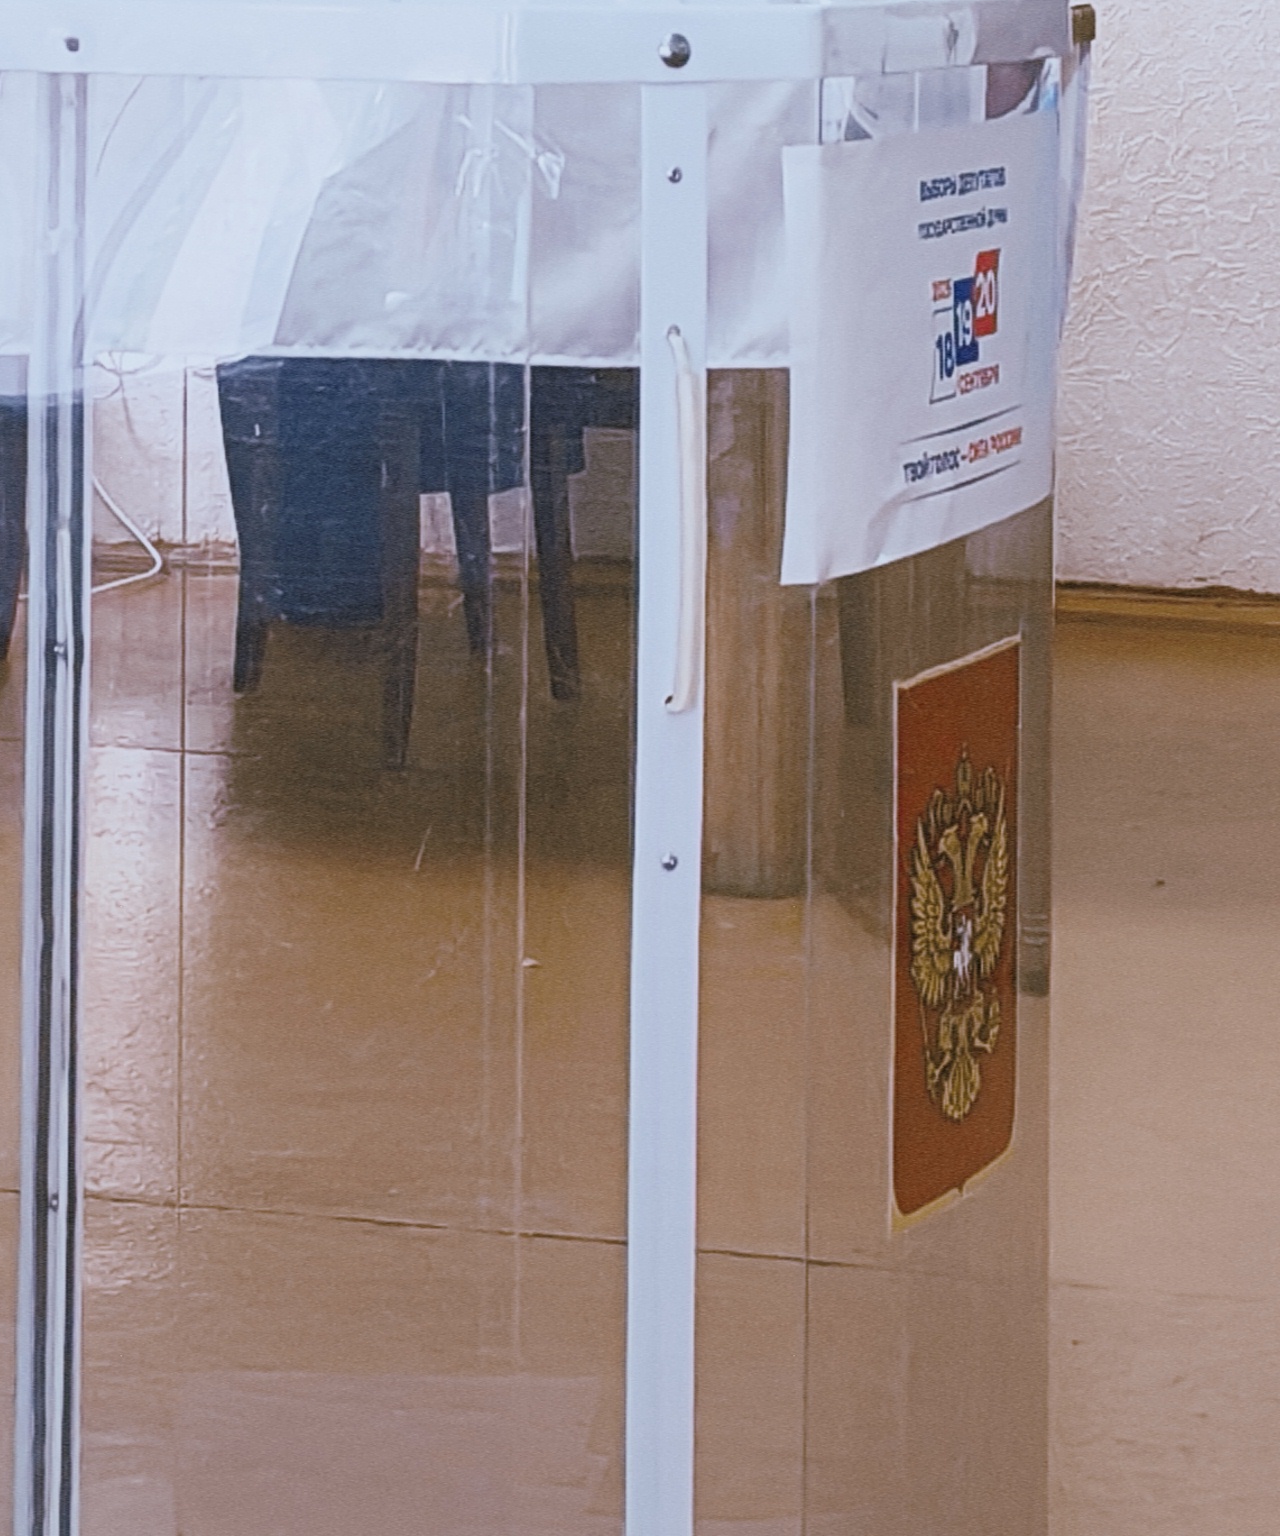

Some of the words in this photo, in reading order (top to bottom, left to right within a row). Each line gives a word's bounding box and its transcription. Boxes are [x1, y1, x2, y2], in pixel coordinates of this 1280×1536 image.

[920, 175, 957, 202] ВЫБОРЫ
[958, 166, 1006, 196] ДЕПУТАТОВ
[976, 268, 996, 318] 20
[956, 299, 973, 347] 19
[935, 331, 955, 381] 18
